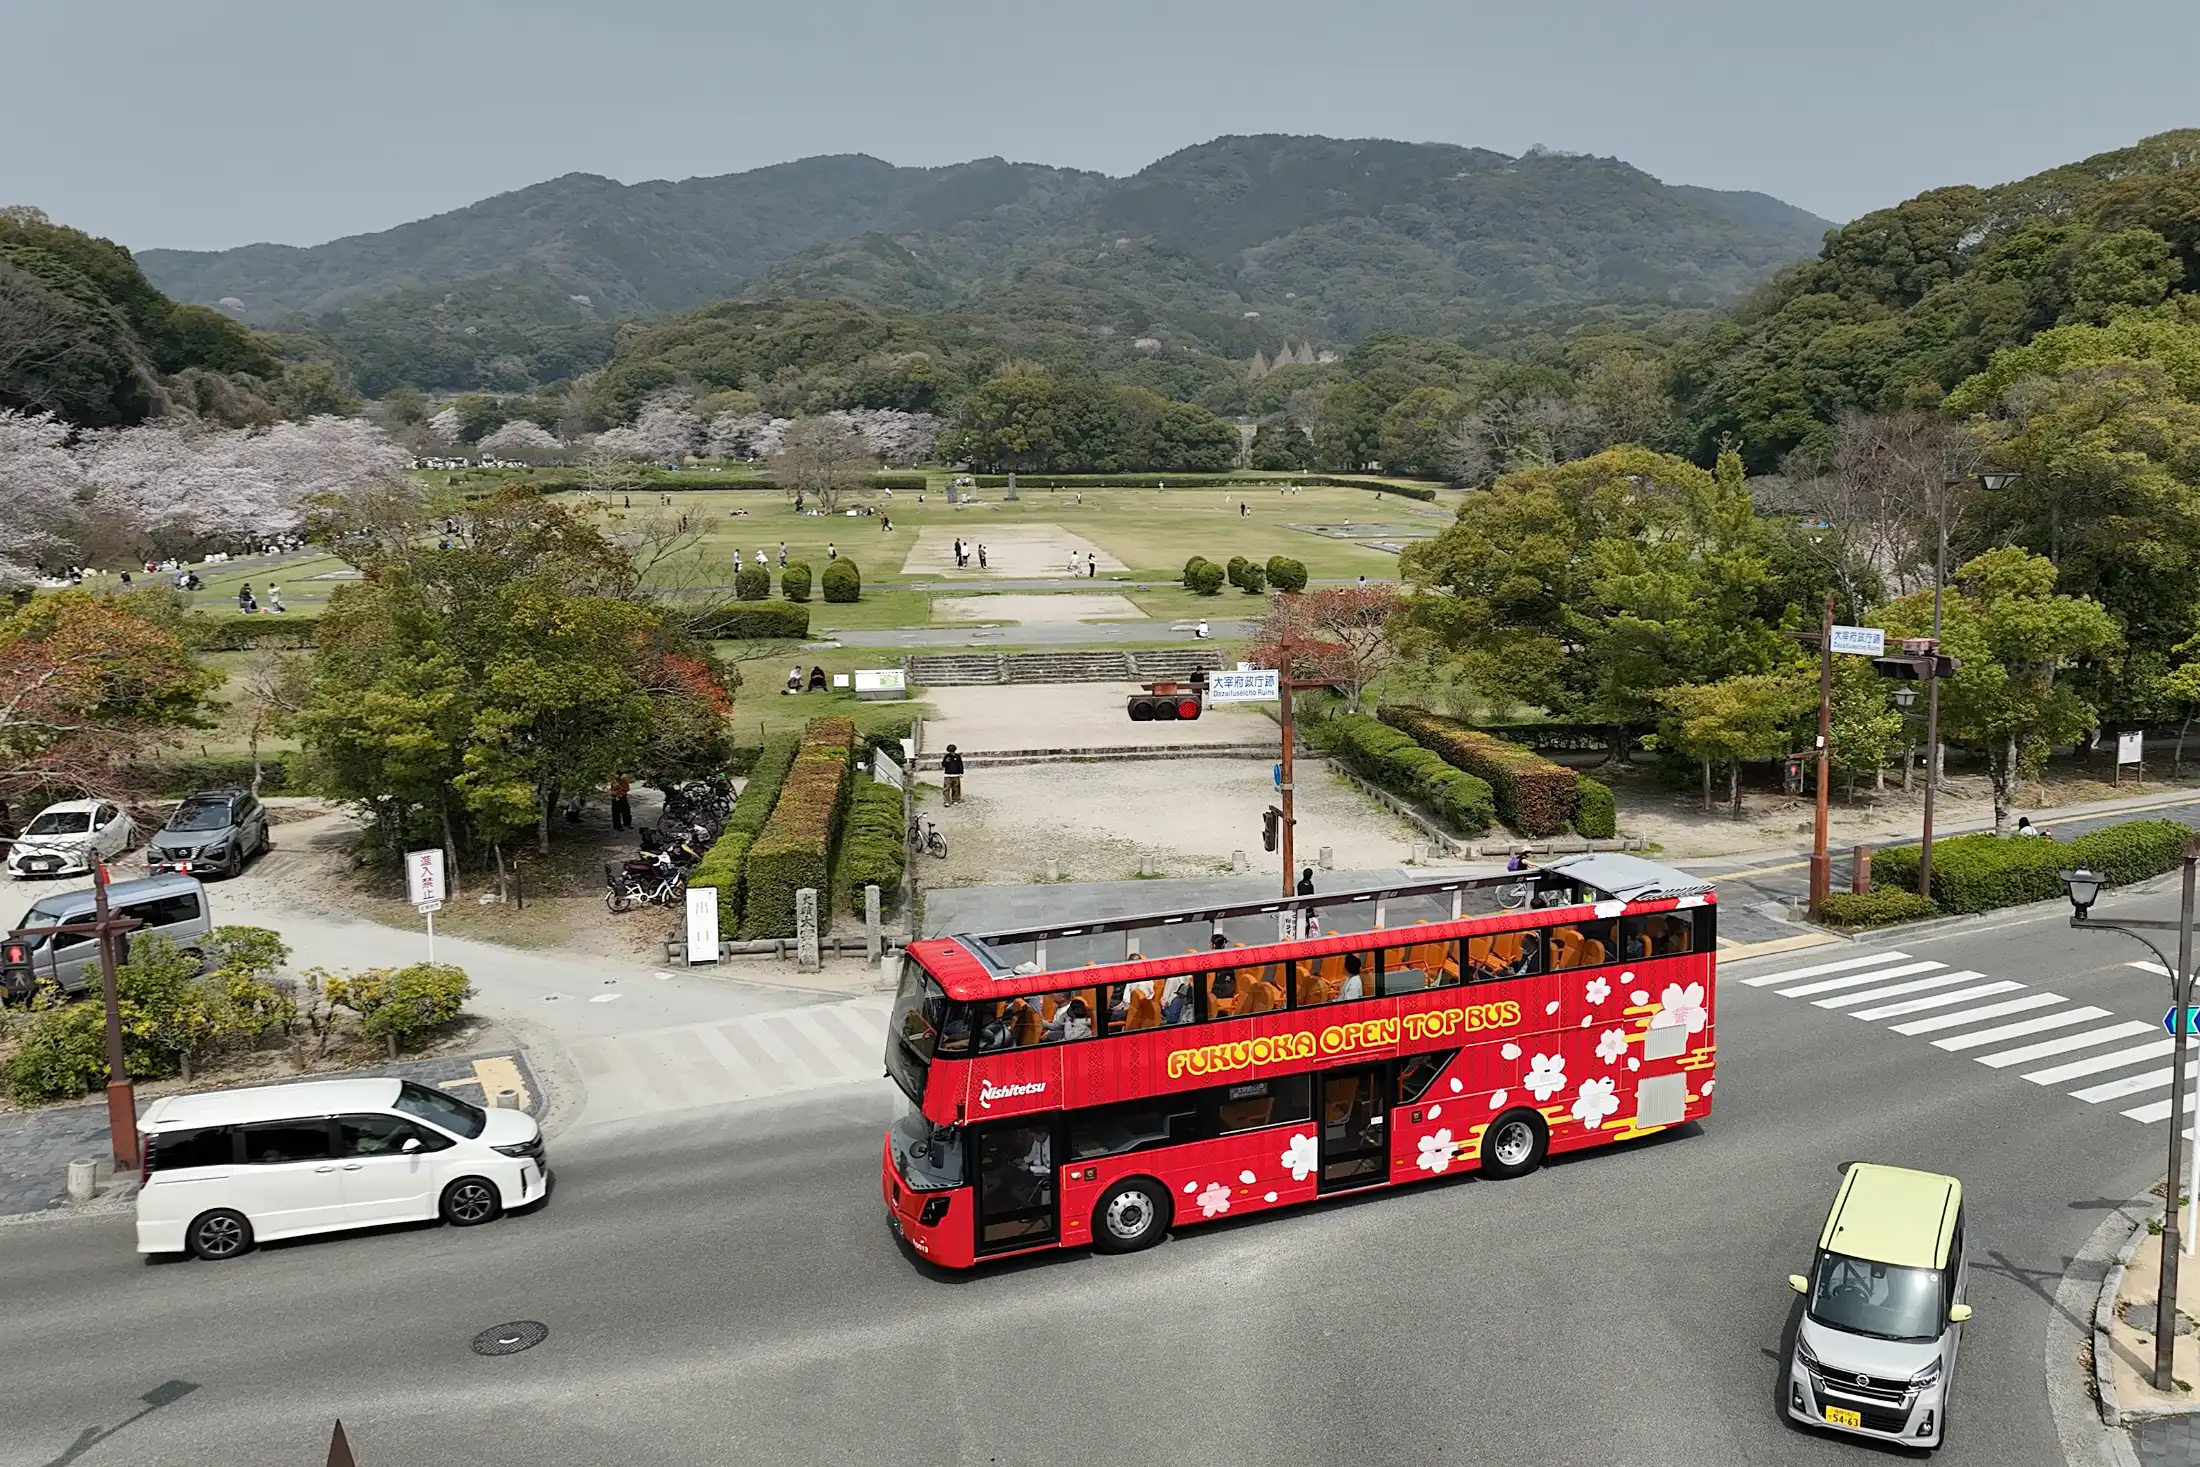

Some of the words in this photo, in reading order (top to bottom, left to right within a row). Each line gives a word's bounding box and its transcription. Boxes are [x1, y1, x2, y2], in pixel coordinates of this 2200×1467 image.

[1213, 675, 1275, 689] 大宰府政庁跡
[1213, 689, 1257, 697] Dazaifuseicho
[1257, 688, 1275, 696] Ruins
[420, 855, 435, 900] 進入禁止
[1168, 1031, 1317, 1079] FUKUOKA
[1320, 1018, 1401, 1053] OPEN
[1403, 1004, 1465, 1041] TOP
[1464, 1000, 1522, 1032] BUS
[979, 1080, 1046, 1108] Nishitetsu
[1833, 1413, 1859, 1427] 54-63
